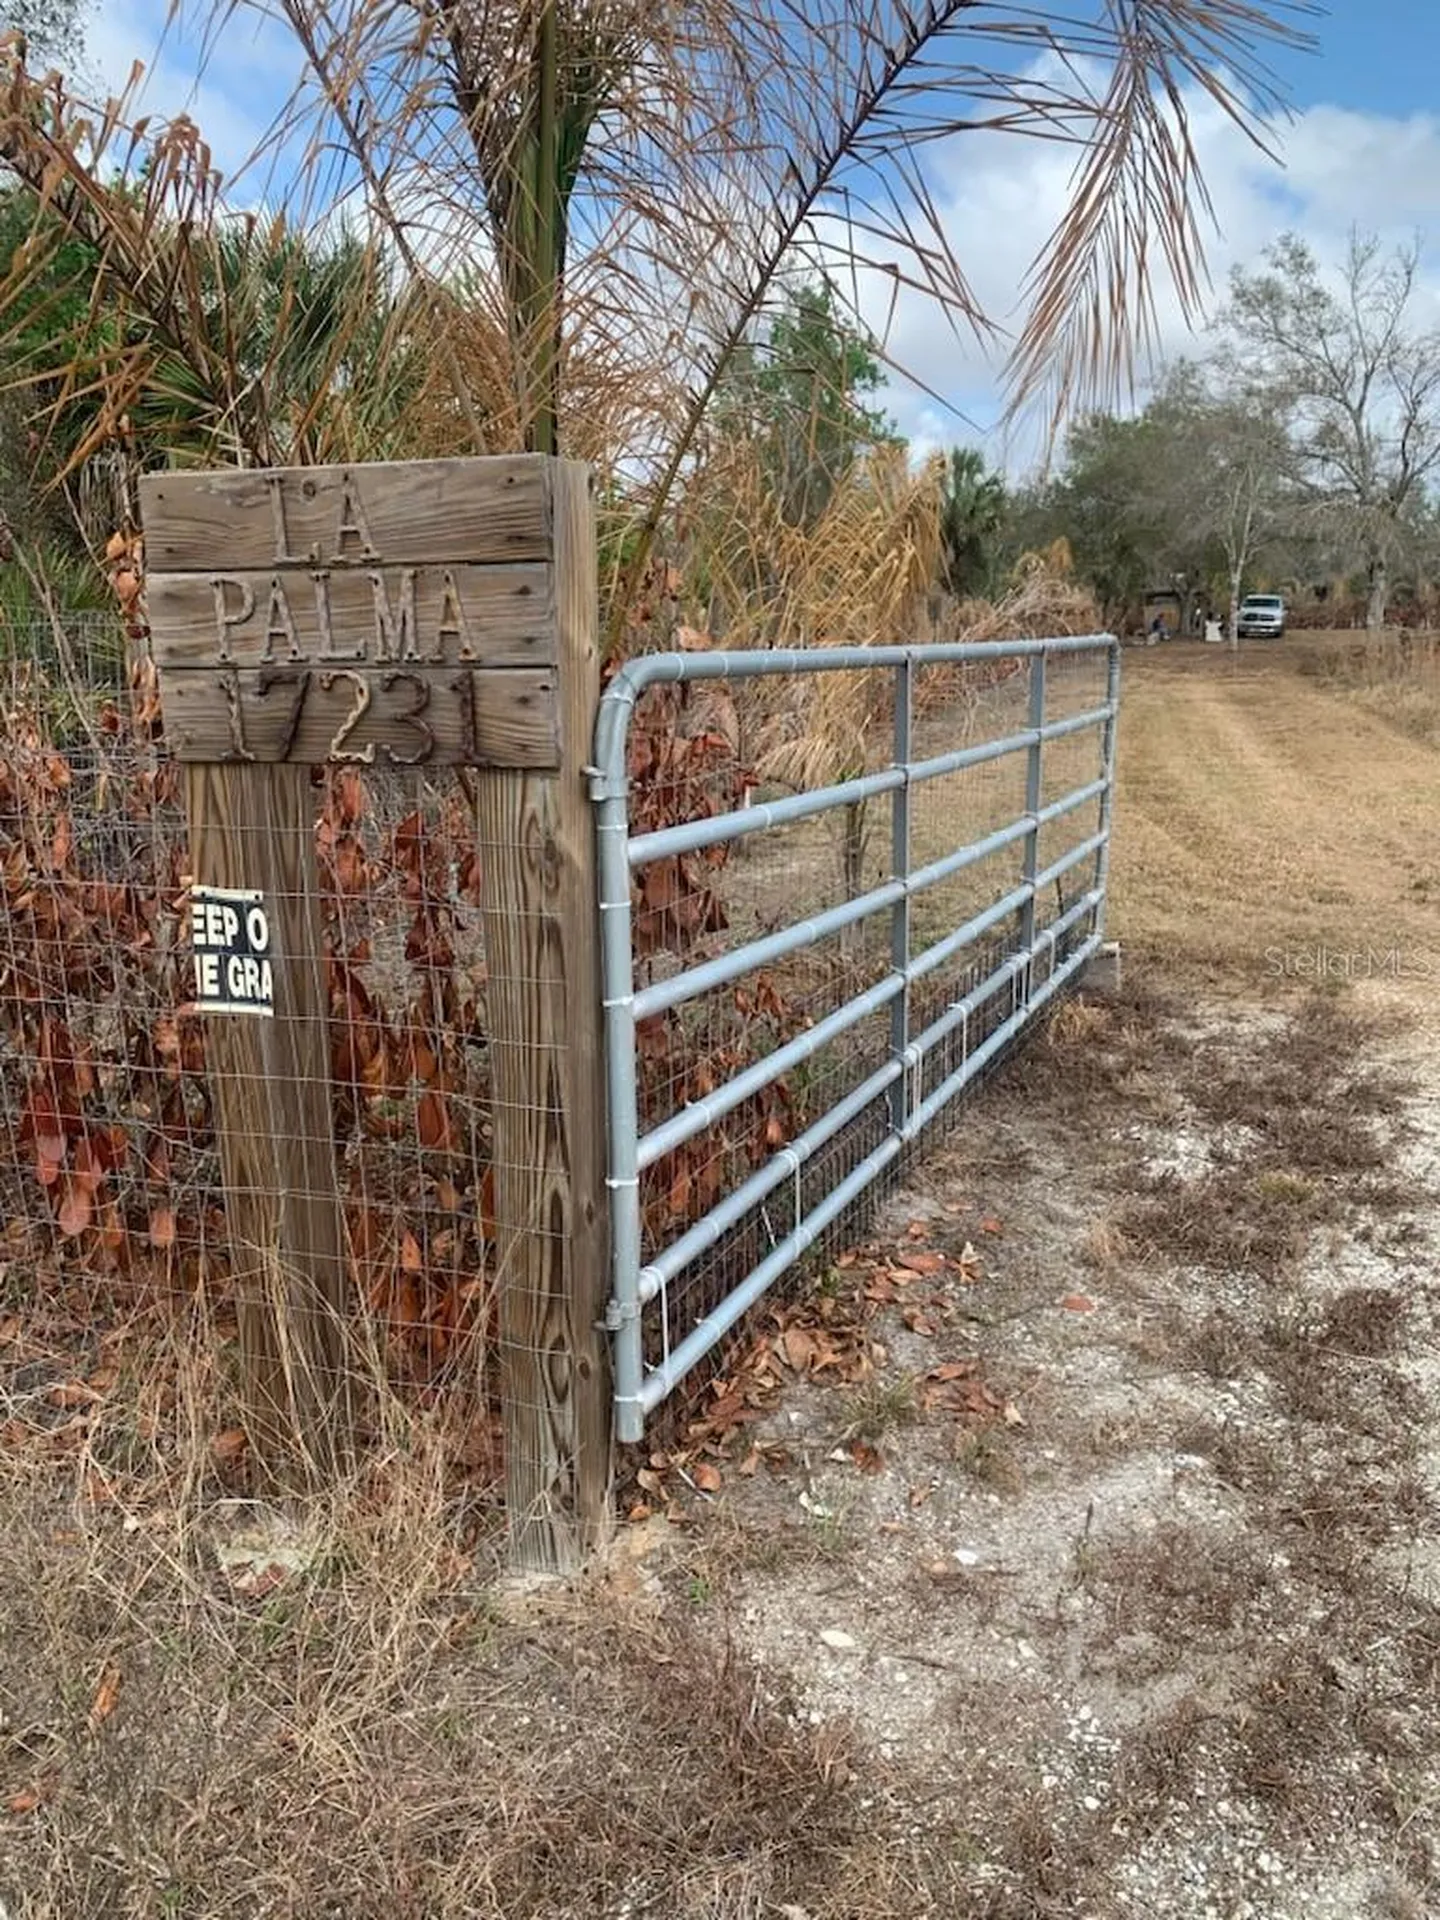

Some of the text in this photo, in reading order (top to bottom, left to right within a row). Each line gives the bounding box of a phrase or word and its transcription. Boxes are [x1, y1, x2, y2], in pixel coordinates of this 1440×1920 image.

[264, 471, 382, 564] LA
[209, 569, 481, 664] PALMA
[217, 668, 488, 765] 17231
[247, 907, 269, 951] O
[227, 955, 274, 1000] GRA
